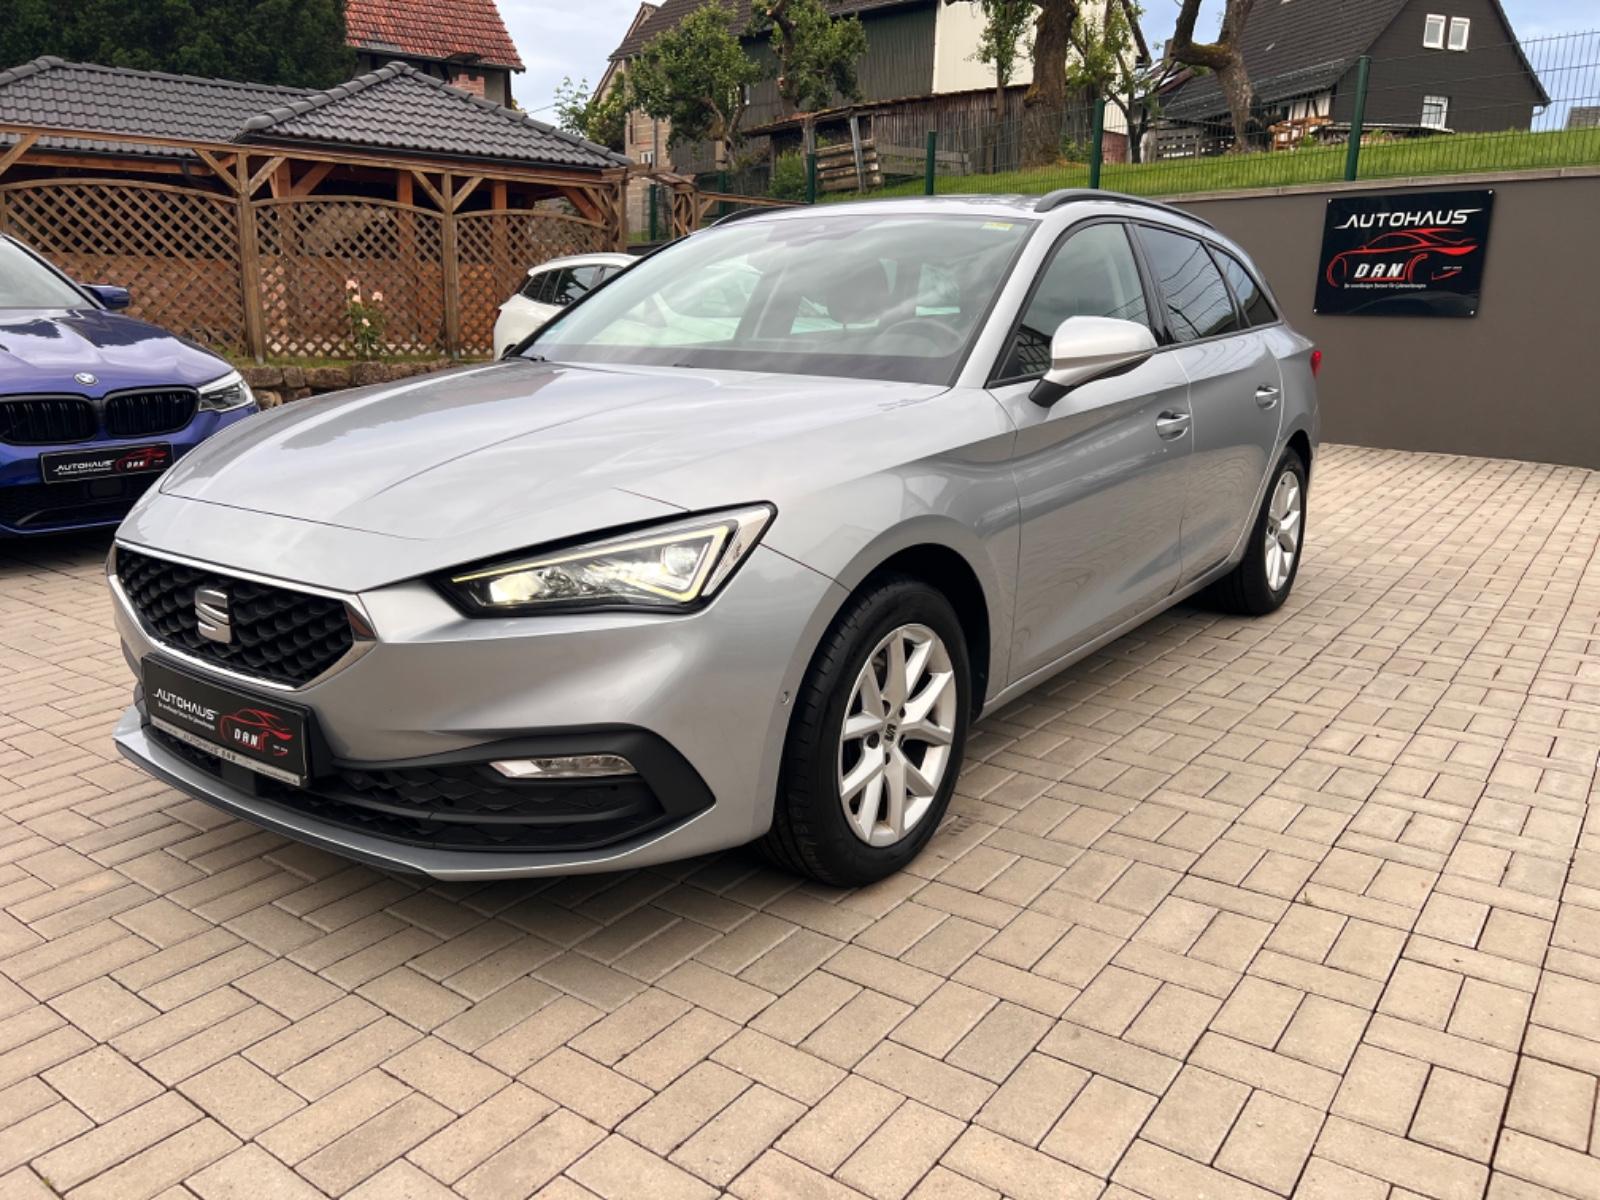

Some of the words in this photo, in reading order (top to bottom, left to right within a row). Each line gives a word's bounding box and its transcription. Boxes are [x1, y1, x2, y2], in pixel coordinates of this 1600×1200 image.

[1334, 207, 1483, 229] AUTOHAUS
[1354, 262, 1404, 279] DAN
[53, 459, 115, 472] AUTOHAUS
[152, 687, 219, 721] AUTOHAUS
[234, 727, 259, 748] DAN
